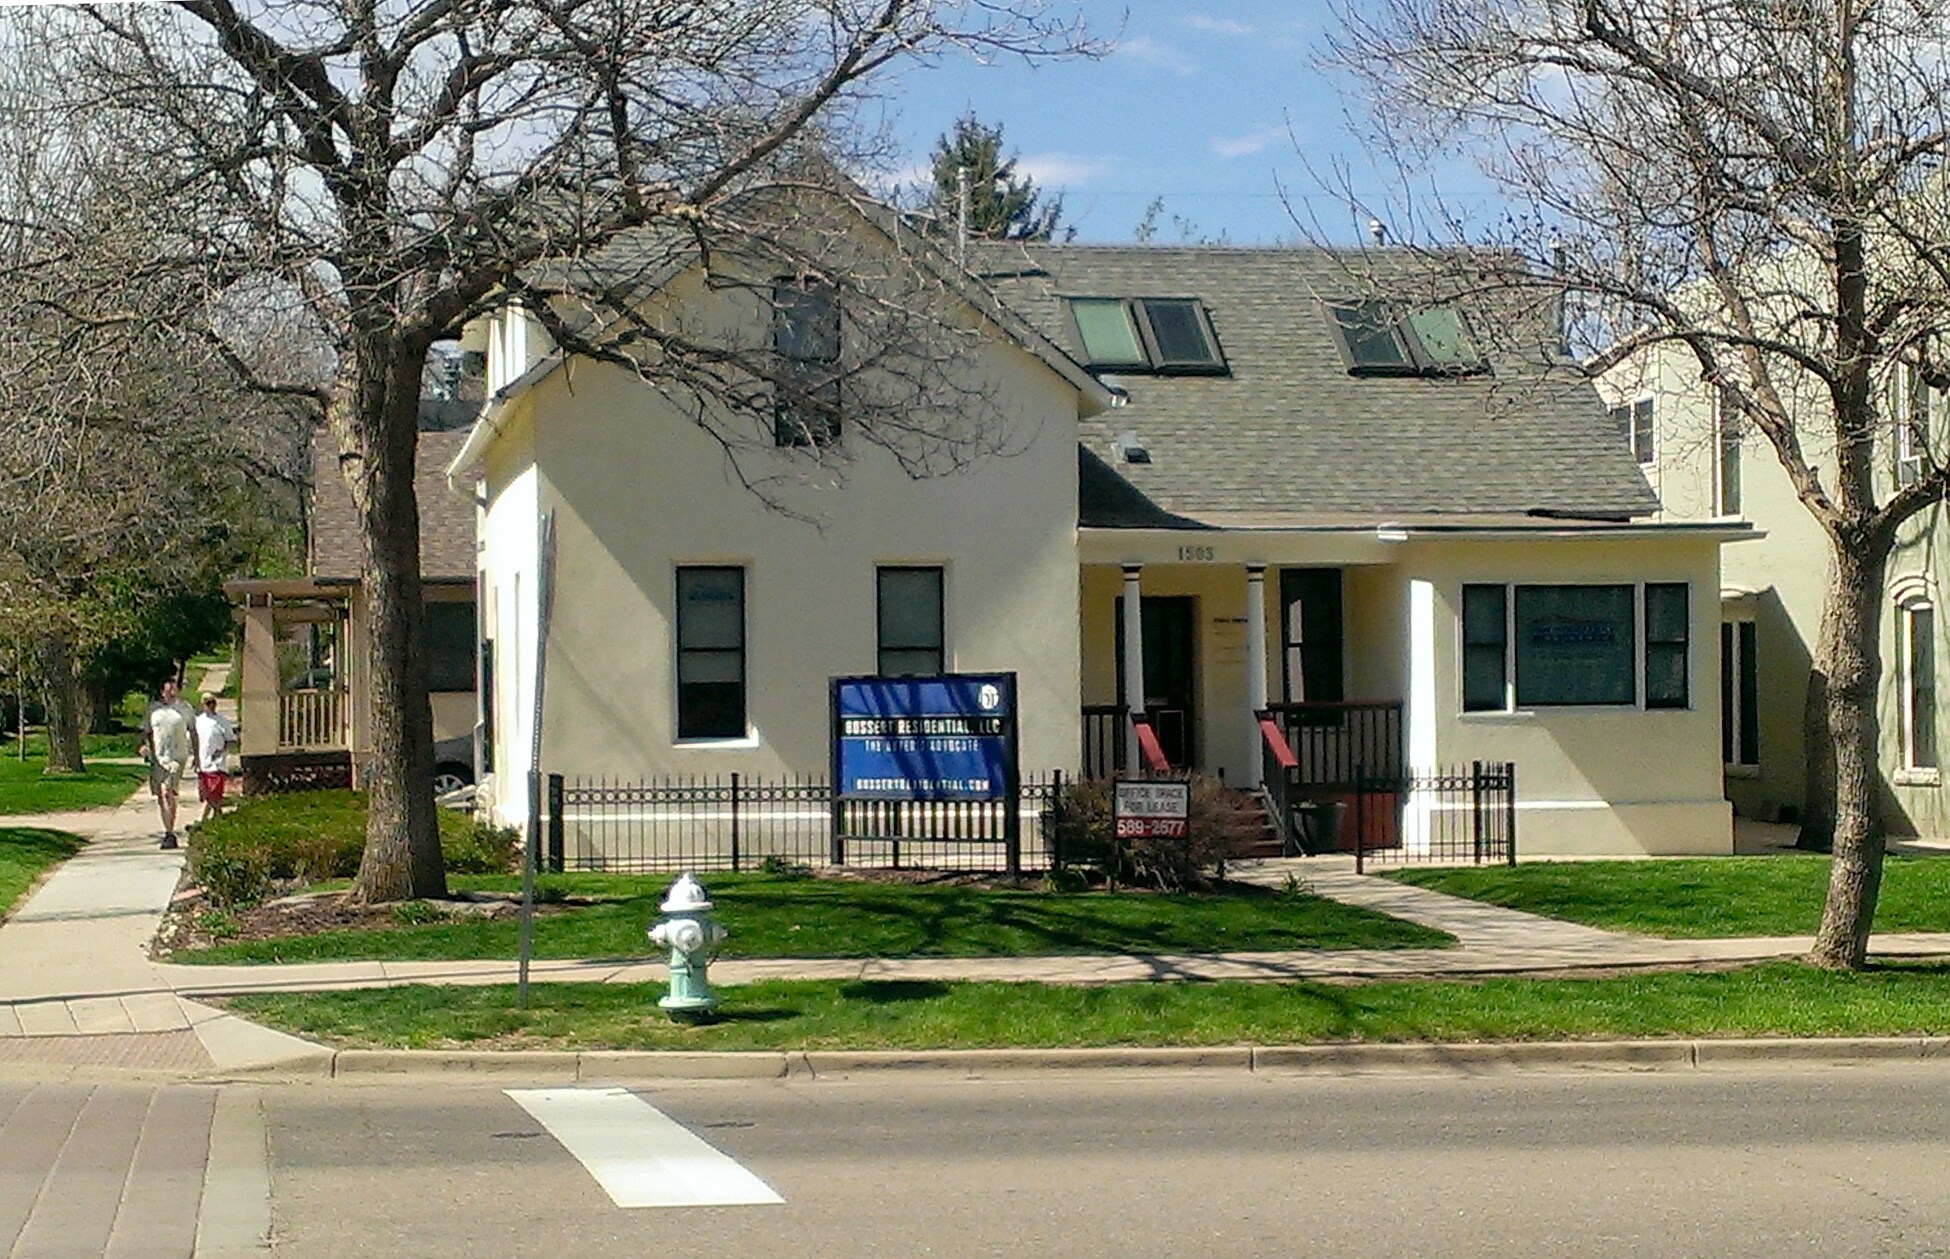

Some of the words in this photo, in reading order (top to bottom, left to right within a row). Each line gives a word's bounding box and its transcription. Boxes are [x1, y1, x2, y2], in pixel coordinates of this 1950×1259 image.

[979, 718, 1001, 734] LLC
[929, 739, 979, 752] ADVOCATE
[1118, 788, 1149, 798] OFFICE
[1155, 788, 1184, 798] SPACE
[1125, 801, 1143, 812] FOR
[1147, 801, 1178, 812] LEASE
[1117, 819, 1185, 836] 589-2677
